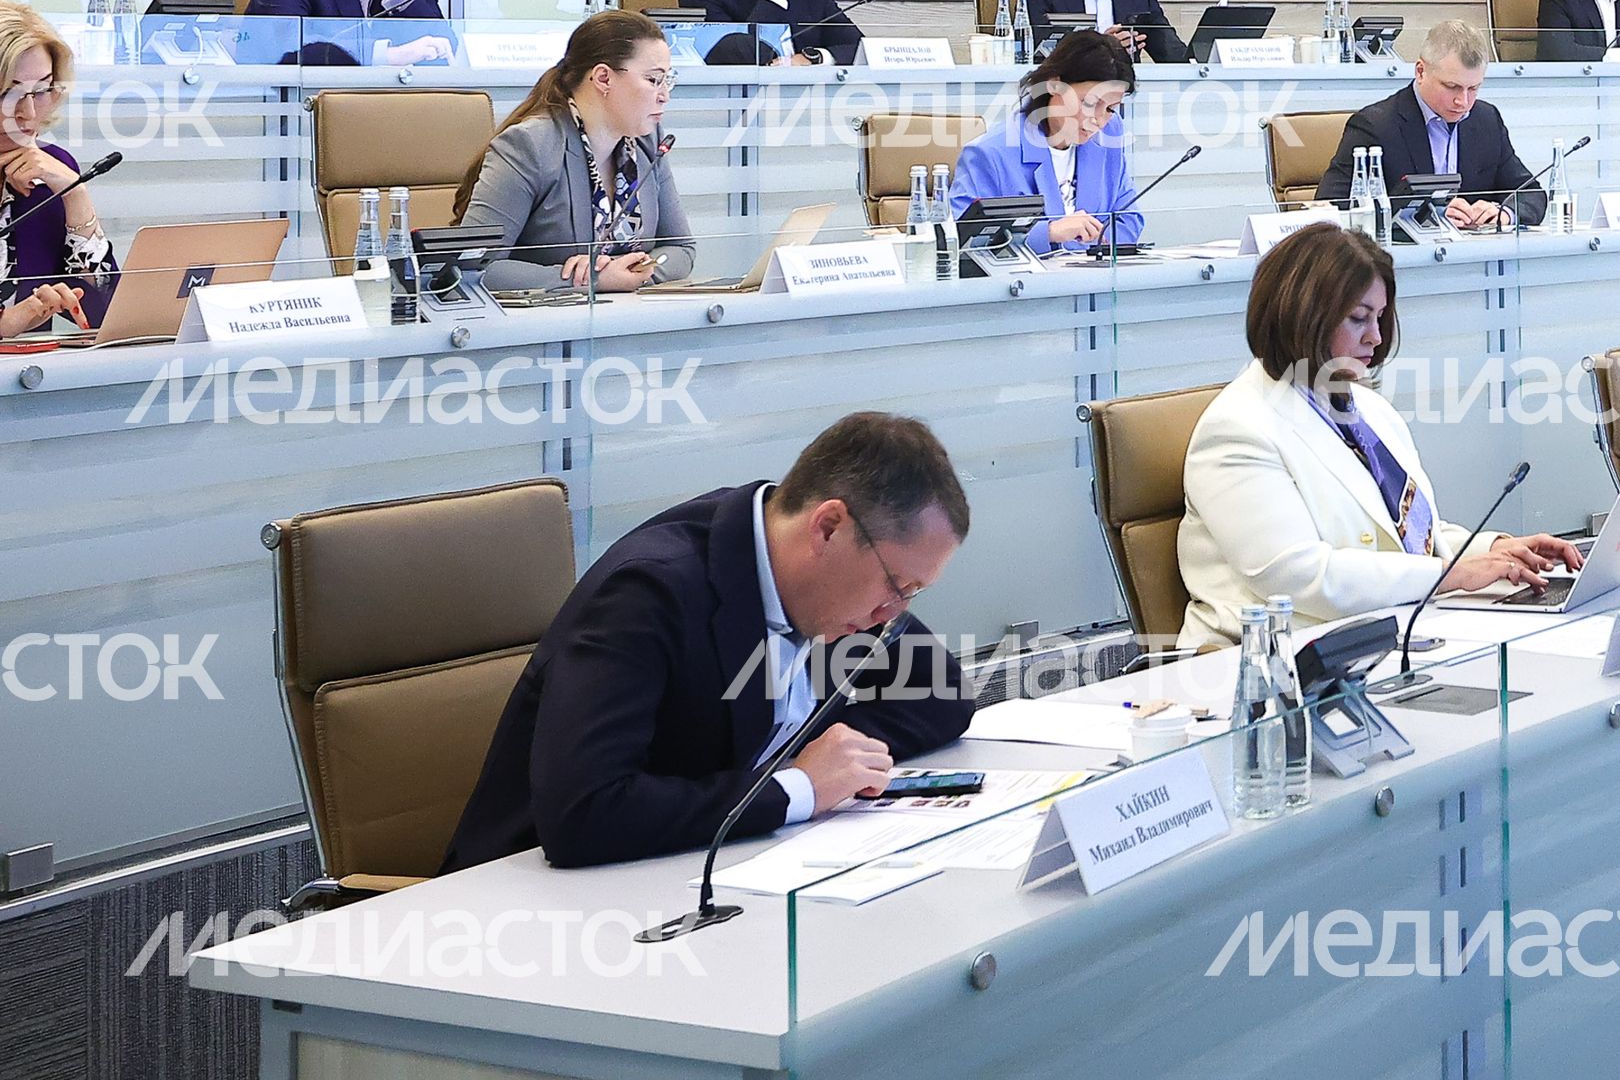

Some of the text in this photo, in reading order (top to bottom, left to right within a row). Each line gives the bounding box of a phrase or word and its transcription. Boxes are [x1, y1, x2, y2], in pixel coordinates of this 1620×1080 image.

[808, 254, 869, 269] ЗИНОВЬЕВА
[841, 269, 897, 282] Анатольевна
[249, 296, 322, 314] КУРТЯНИК
[228, 314, 352, 334] Надежда Васильевна
[1114, 784, 1171, 823] ХАЙКИН
[1088, 798, 1214, 865] Михаил Владимирович
